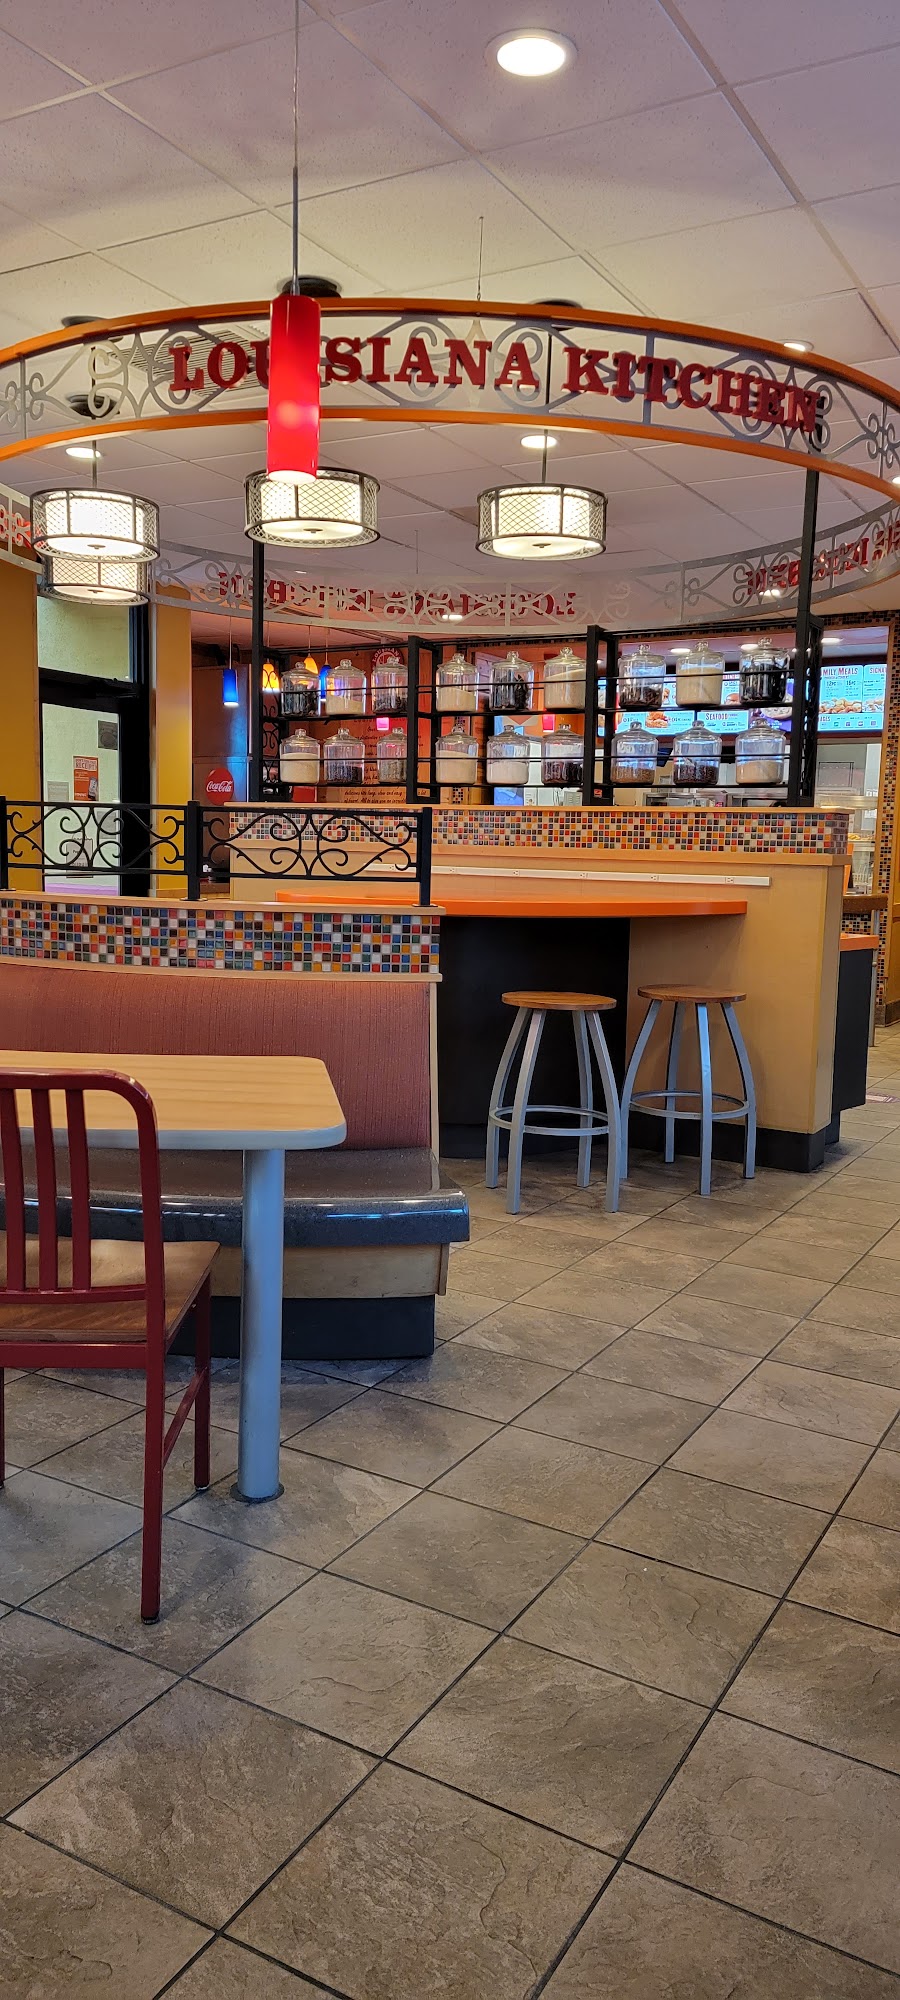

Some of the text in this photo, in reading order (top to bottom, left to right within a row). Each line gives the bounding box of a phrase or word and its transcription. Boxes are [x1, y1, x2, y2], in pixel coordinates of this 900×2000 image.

[168, 336, 820, 432] LOUSIANA KITCHEN
[206, 780, 234, 793] Coca-Cola
